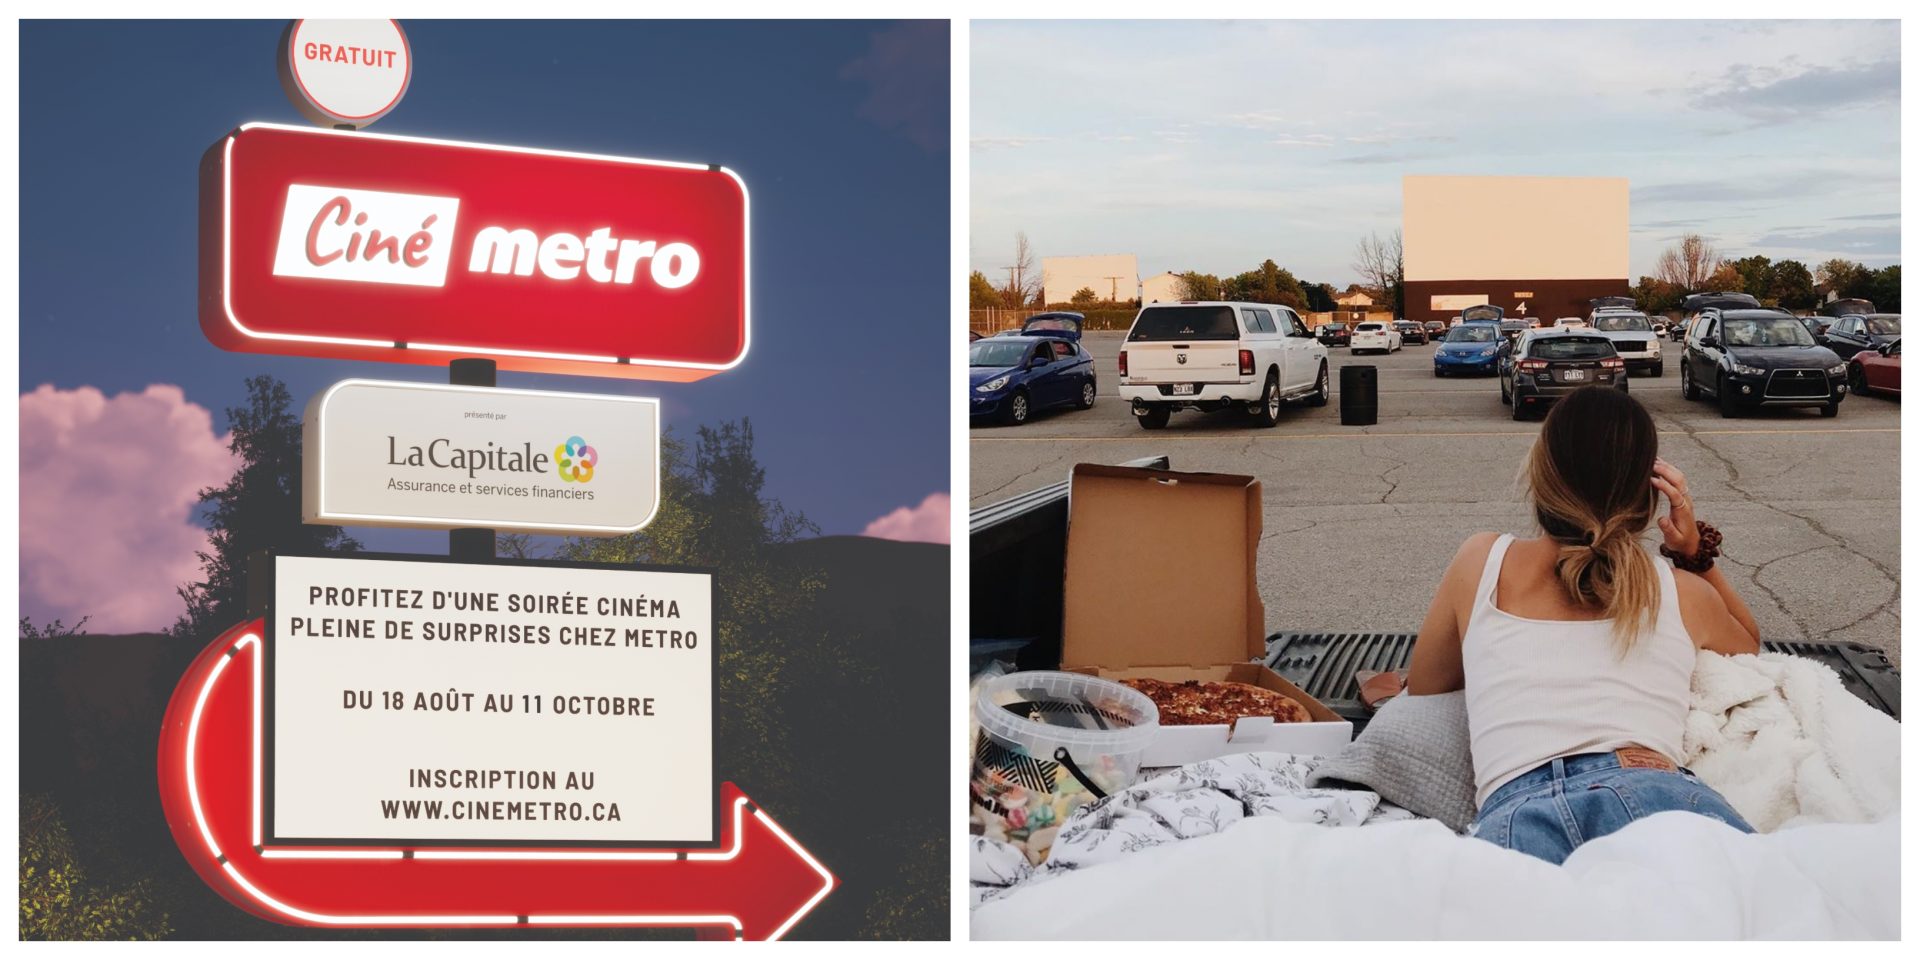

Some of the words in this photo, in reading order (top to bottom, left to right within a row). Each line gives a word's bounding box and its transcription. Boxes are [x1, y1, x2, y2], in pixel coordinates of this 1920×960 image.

[303, 41, 397, 69] GRATUIT
[306, 196, 437, 267] Ciné
[468, 226, 701, 289] metro
[1515, 301, 1527, 315] 4
[463, 410, 495, 420] présenté
[495, 413, 508, 421] par
[387, 477, 456, 494] Assurance
[459, 482, 473, 495] et
[475, 483, 529, 497] services
[532, 485, 595, 501] financiers
[309, 585, 424, 610] PROFITEZ
[432, 590, 499, 612] D'UNE
[507, 590, 589, 616] SOIRÉE
[597, 593, 681, 619] CINÉMA
[290, 616, 376, 639] PLEINE
[385, 620, 414, 641] DE
[422, 621, 551, 645] SURPRISES
[559, 626, 616, 647] CHEZ
[624, 628, 698, 650] METRO
[343, 689, 373, 710] DU
[382, 690, 404, 711] 18
[413, 687, 475, 712] AOÛT
[483, 693, 513, 713] AU
[522, 694, 542, 714] 11
[552, 695, 655, 717] OCTOBRE
[409, 768, 556, 790] INSCRIPTION
[565, 771, 594, 791] AU
[381, 799, 621, 822] WWW.CINEMETRO.CA
